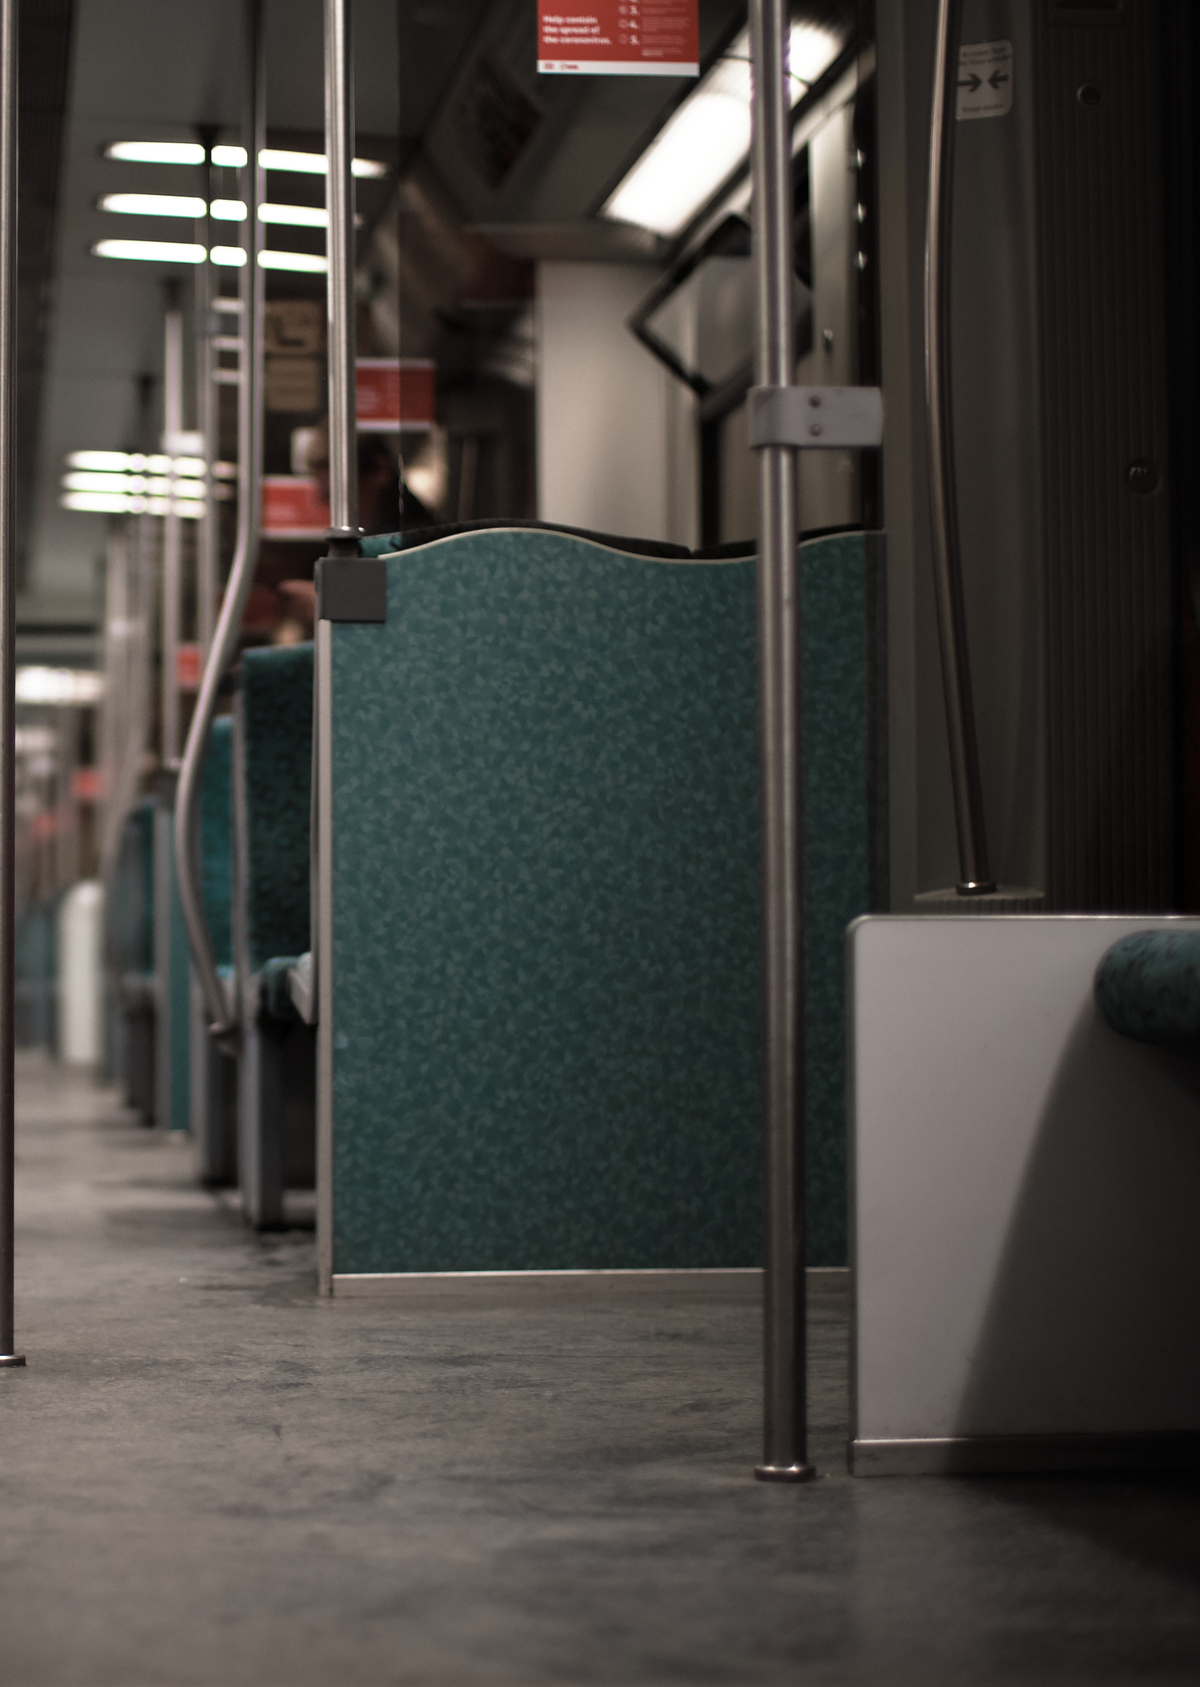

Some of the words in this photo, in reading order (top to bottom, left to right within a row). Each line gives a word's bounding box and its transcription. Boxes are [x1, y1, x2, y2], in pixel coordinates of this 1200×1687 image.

[542, 15, 563, 25] Help
[565, 16, 598, 25] contain
[542, 25, 558, 34] the
[560, 26, 590, 36] spread
[591, 25, 600, 34] of
[542, 36, 558, 44] the
[559, 37, 613, 45] coronavirus.
